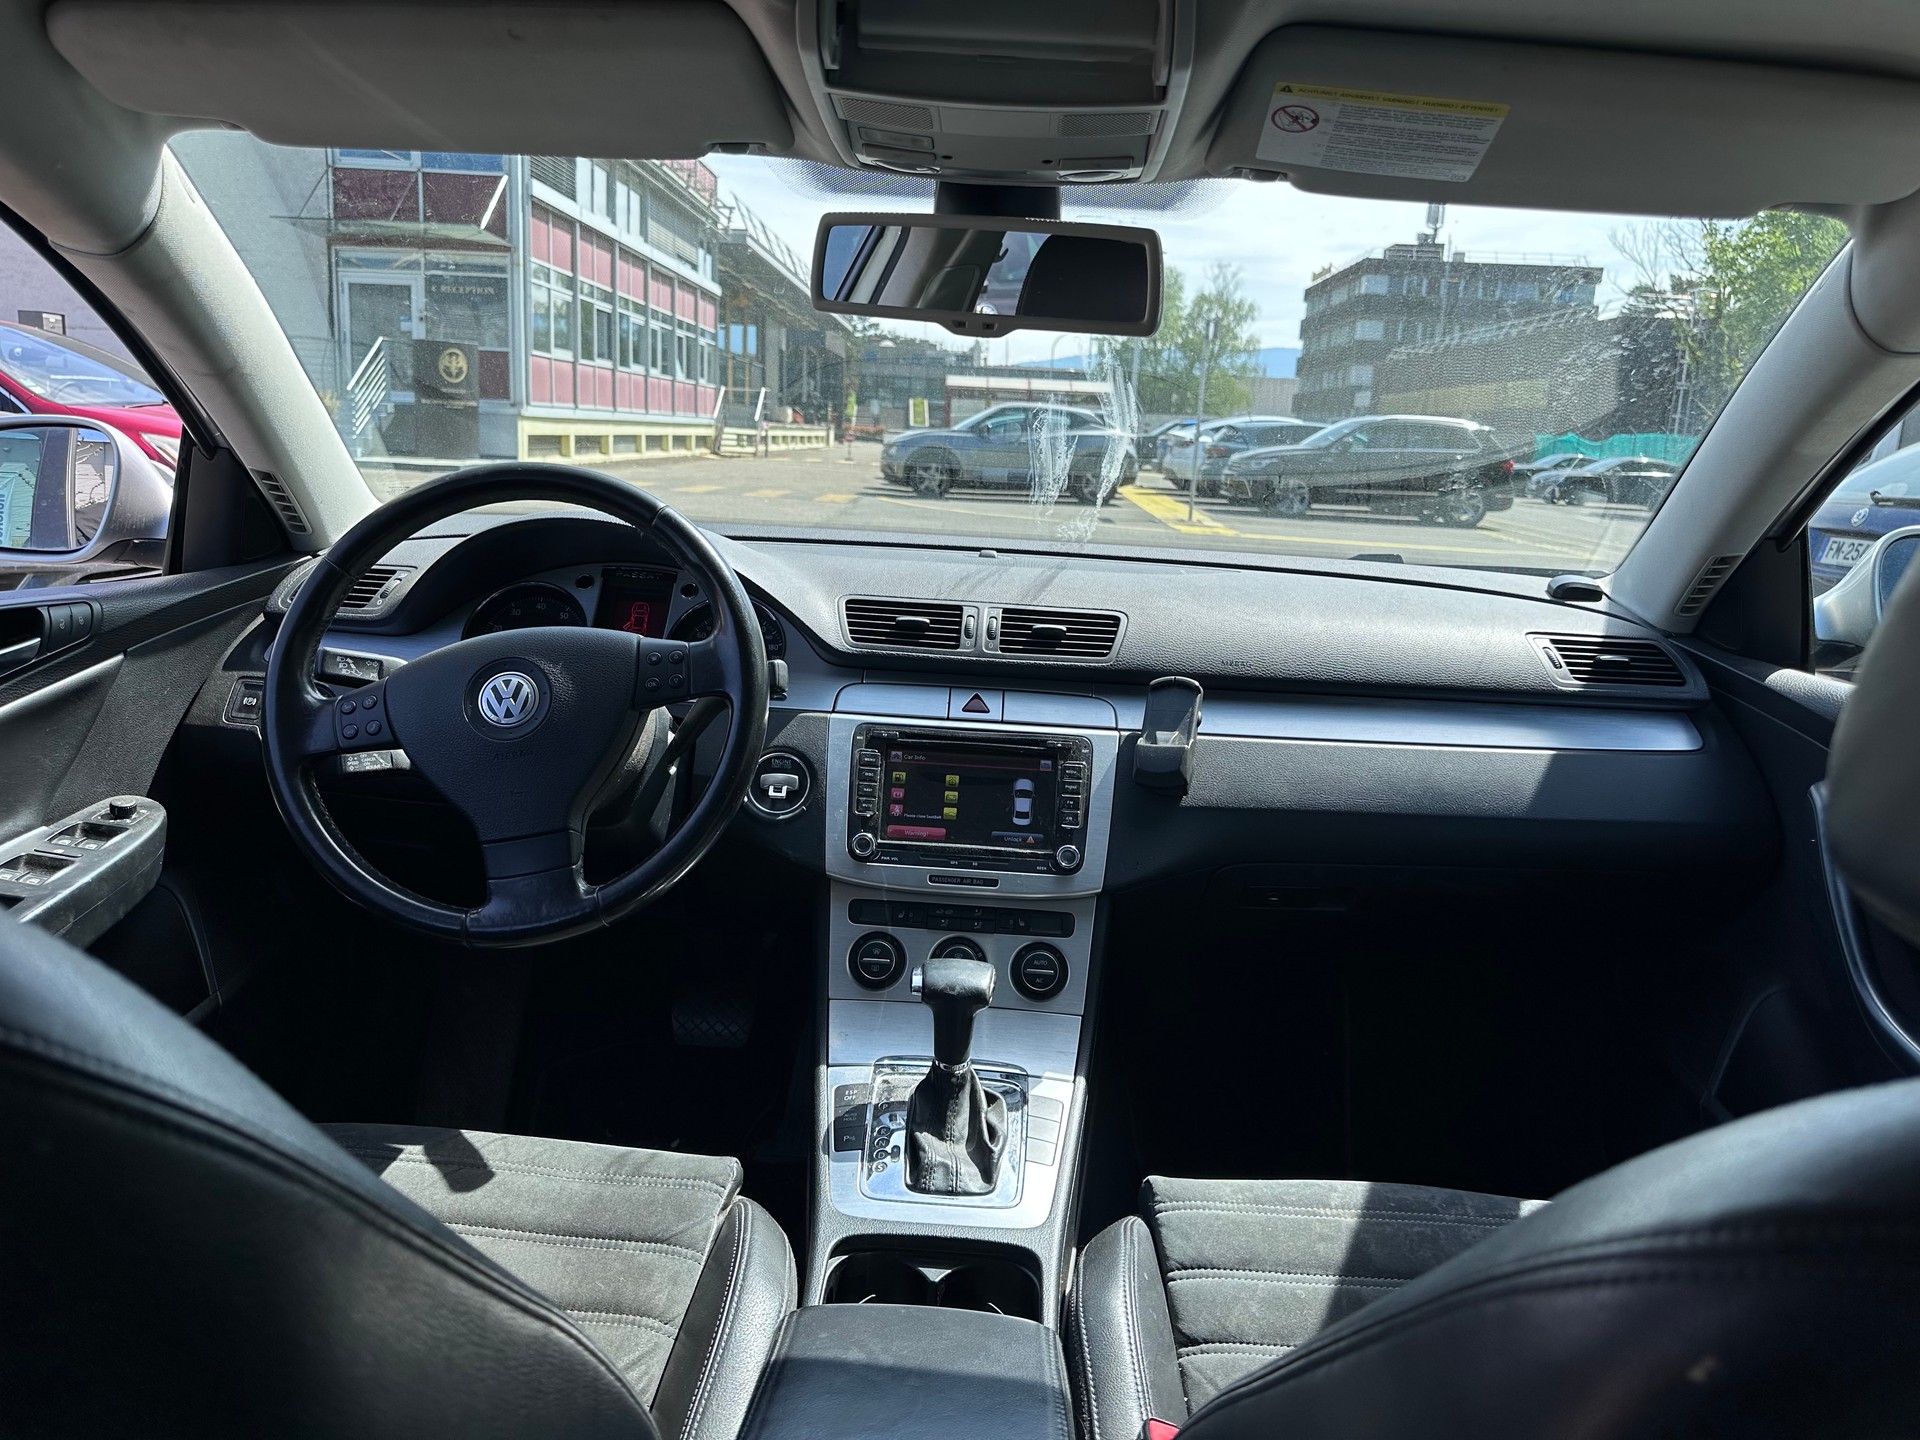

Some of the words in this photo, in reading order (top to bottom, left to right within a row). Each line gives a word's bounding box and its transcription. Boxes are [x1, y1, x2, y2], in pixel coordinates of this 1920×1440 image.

[615, 570, 663, 580] PASSAT
[536, 602, 546, 610] 40
[511, 608, 521, 616] 30
[482, 675, 535, 724] VW
[904, 829, 929, 837] Warning!
[931, 876, 961, 884] PASSENGER
